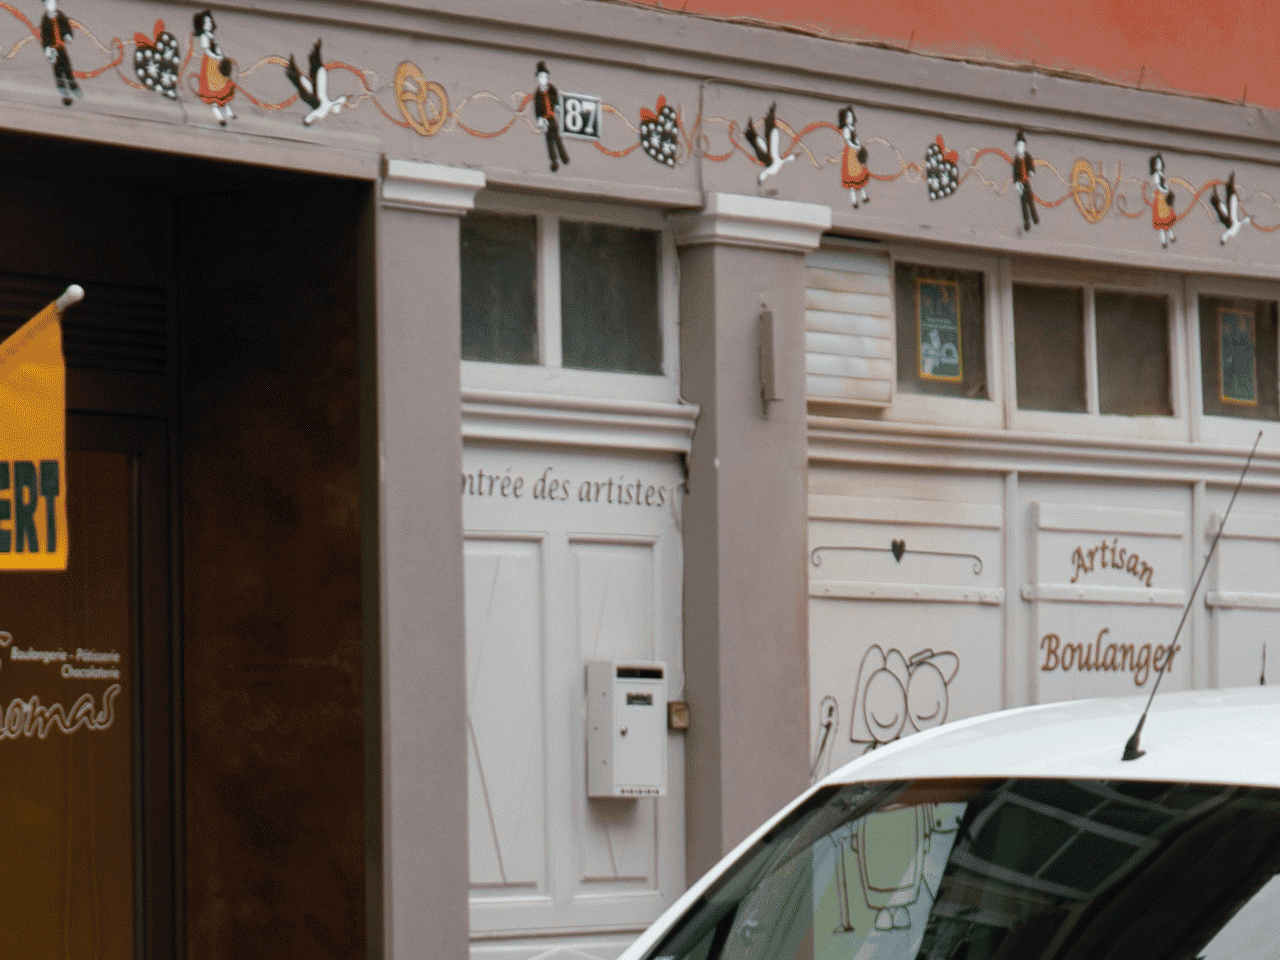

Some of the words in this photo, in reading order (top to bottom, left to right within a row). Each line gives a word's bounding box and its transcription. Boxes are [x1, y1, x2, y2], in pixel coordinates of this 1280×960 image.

[565, 98, 597, 134] 87
[461, 466, 524, 498] ntrée
[532, 465, 571, 502] des
[577, 474, 667, 508] artistes
[1070, 537, 1154, 588] Artisan
[1040, 627, 1181, 687] Boulanger
